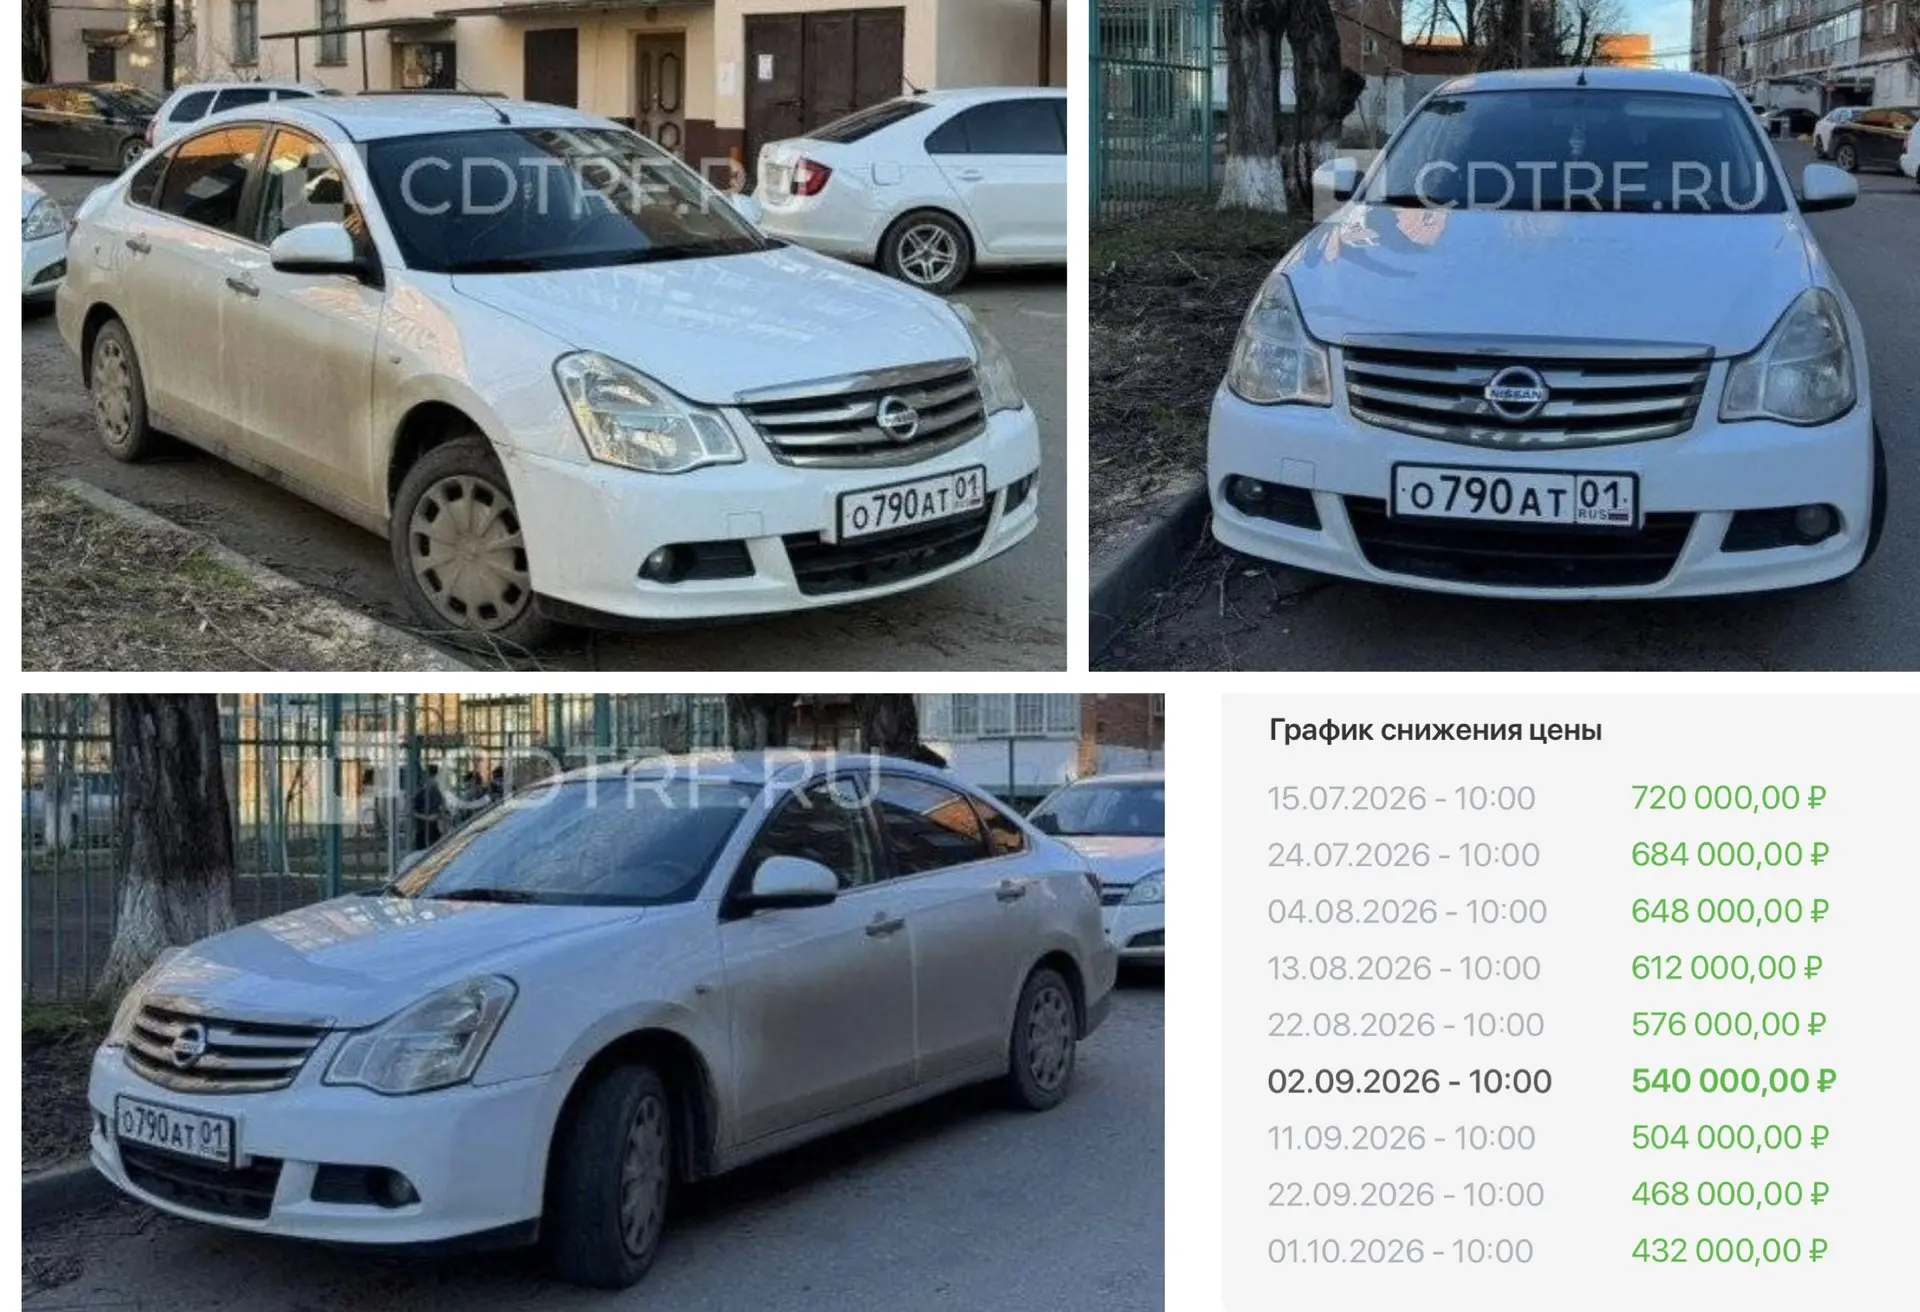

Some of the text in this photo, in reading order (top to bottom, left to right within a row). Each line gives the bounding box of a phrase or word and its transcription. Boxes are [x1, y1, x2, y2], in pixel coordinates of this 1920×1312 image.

[1491, 387, 1541, 398] NISSAN
[955, 473, 977, 499] 01
[1579, 479, 1619, 509] 01
[1578, 508, 1608, 520] RUS
[201, 1120, 222, 1149] 01
